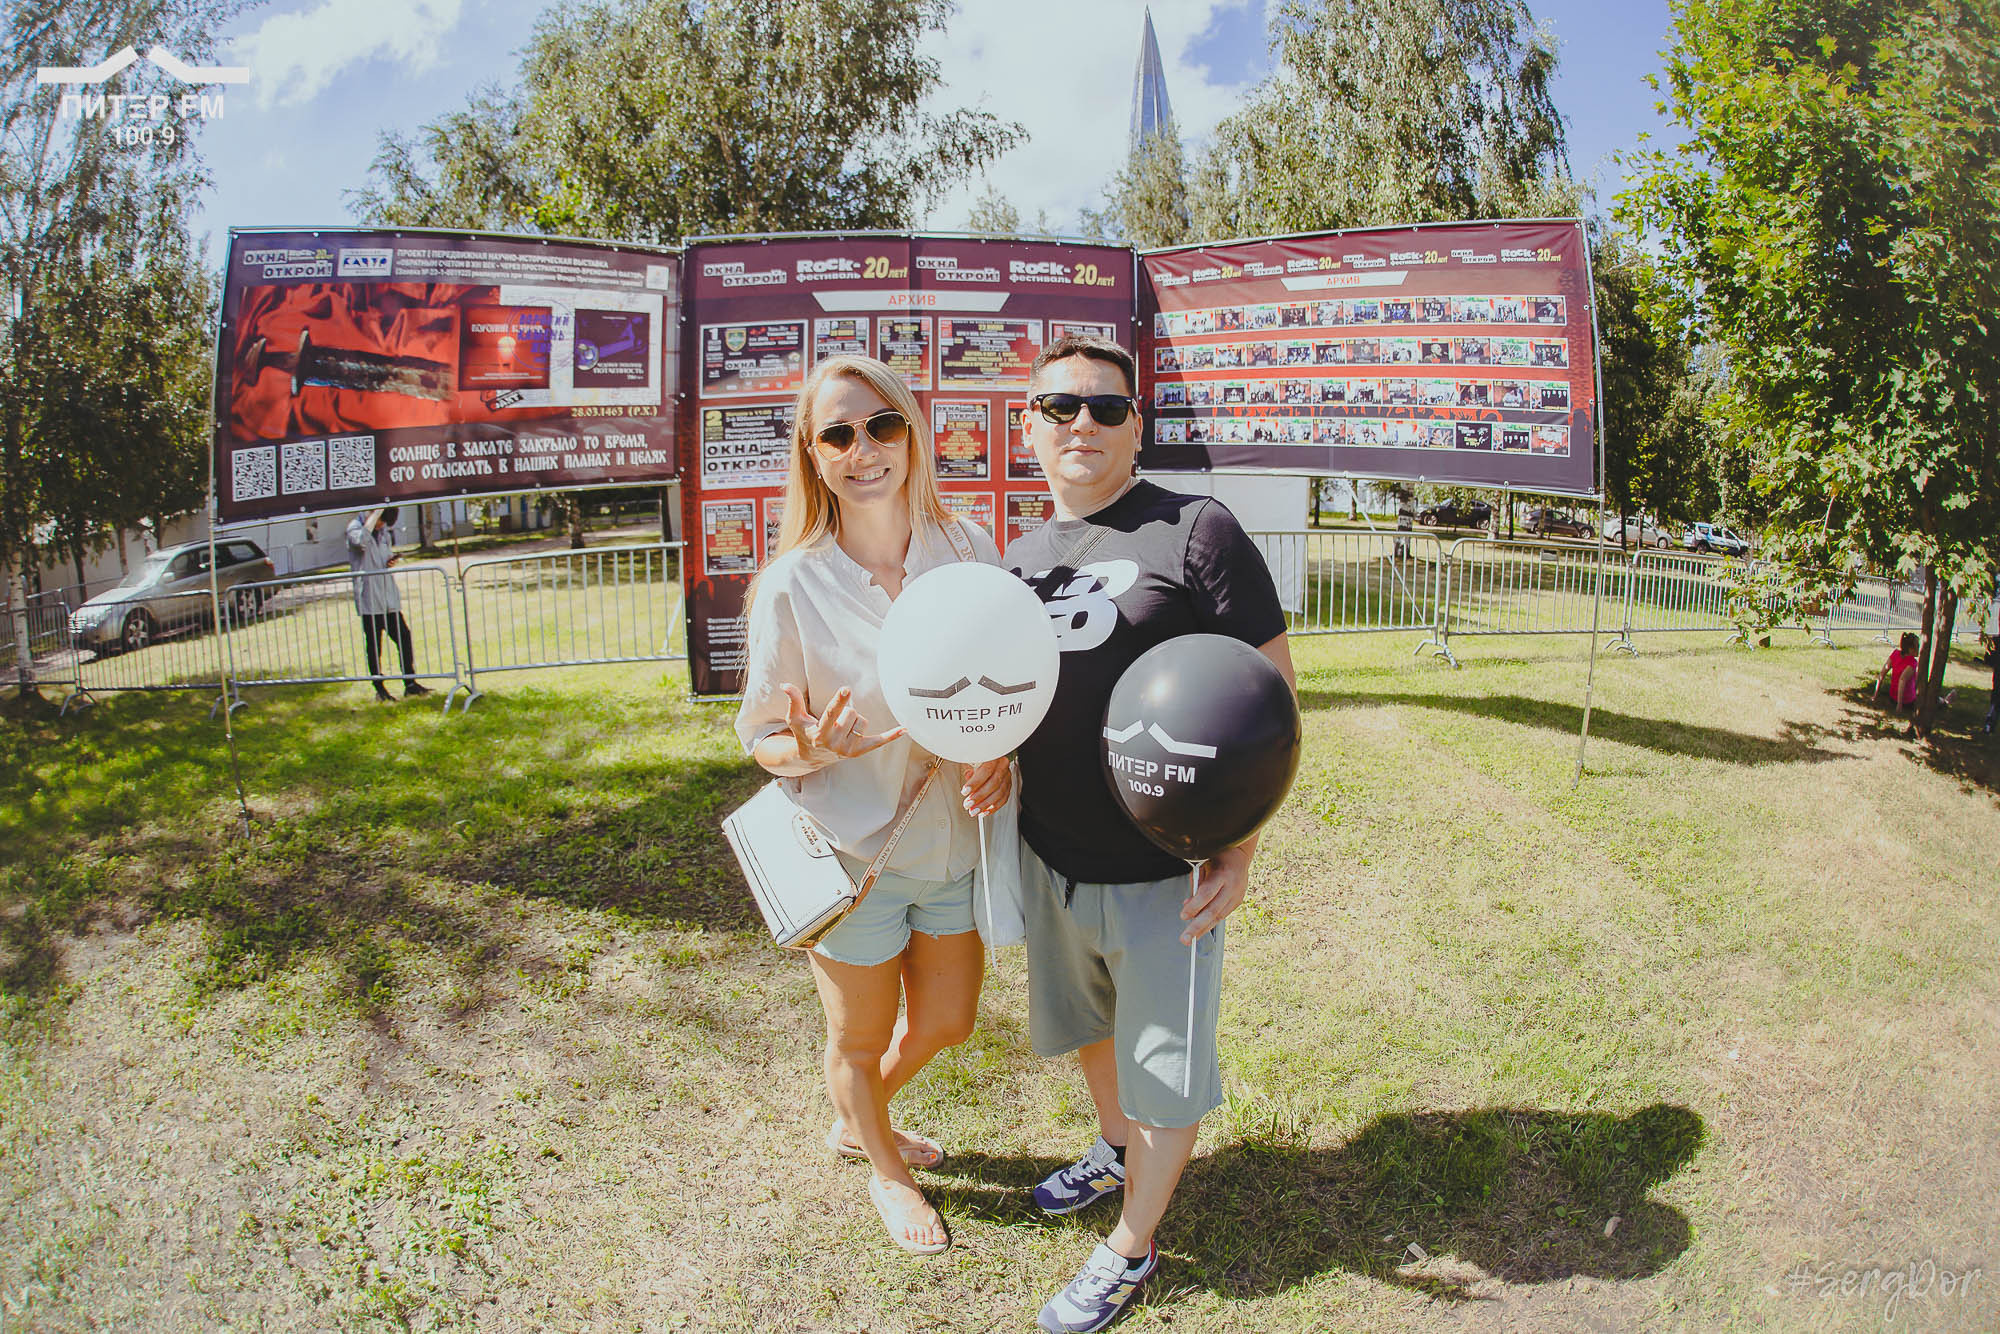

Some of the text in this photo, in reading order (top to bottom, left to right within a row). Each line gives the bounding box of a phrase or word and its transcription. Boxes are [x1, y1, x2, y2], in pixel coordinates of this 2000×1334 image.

[245, 252, 287, 264] ОКНА
[1424, 251, 1438, 264] 20
[1537, 248, 1551, 262] 20
[264, 261, 332, 277] ОТКРОЙ!
[705, 264, 743, 275] ОКНА
[863, 256, 889, 279] 20
[917, 258, 956, 269] ОКНА
[1319, 257, 1332, 270] 20
[724, 270, 786, 286] ОТКРОЙ!
[937, 268, 1000, 282] ОТКРОЙ!
[1073, 263, 1098, 286] 20
[1221, 266, 1233, 278] 20
[1326, 275, 1360, 286] АРХИВ
[888, 293, 936, 306] АРХИВ
[708, 328, 718, 340] 1
[817, 344, 841, 352] ОКНА
[726, 361, 756, 370] ОКНА
[571, 407, 623, 417] 28.03.1463
[705, 410, 722, 427] 2
[389, 433, 648, 463] СОЛНЦЕ В ЗАКАТЕ ЗАКРЫЛО ТО ВРЕМЯ,
[707, 443, 759, 456] ОКНА
[390, 450, 667, 482] ЕГО ОТЫСКАТЬ В НАШИХ ПЛАНАХ И ЦЕЛЯХ
[926, 702, 1023, 721] ПИТЕР FM
[960, 723, 996, 733] 100.9
[1108, 750, 1196, 784] ПИТЕР FM
[1128, 779, 1165, 798] 100.9
